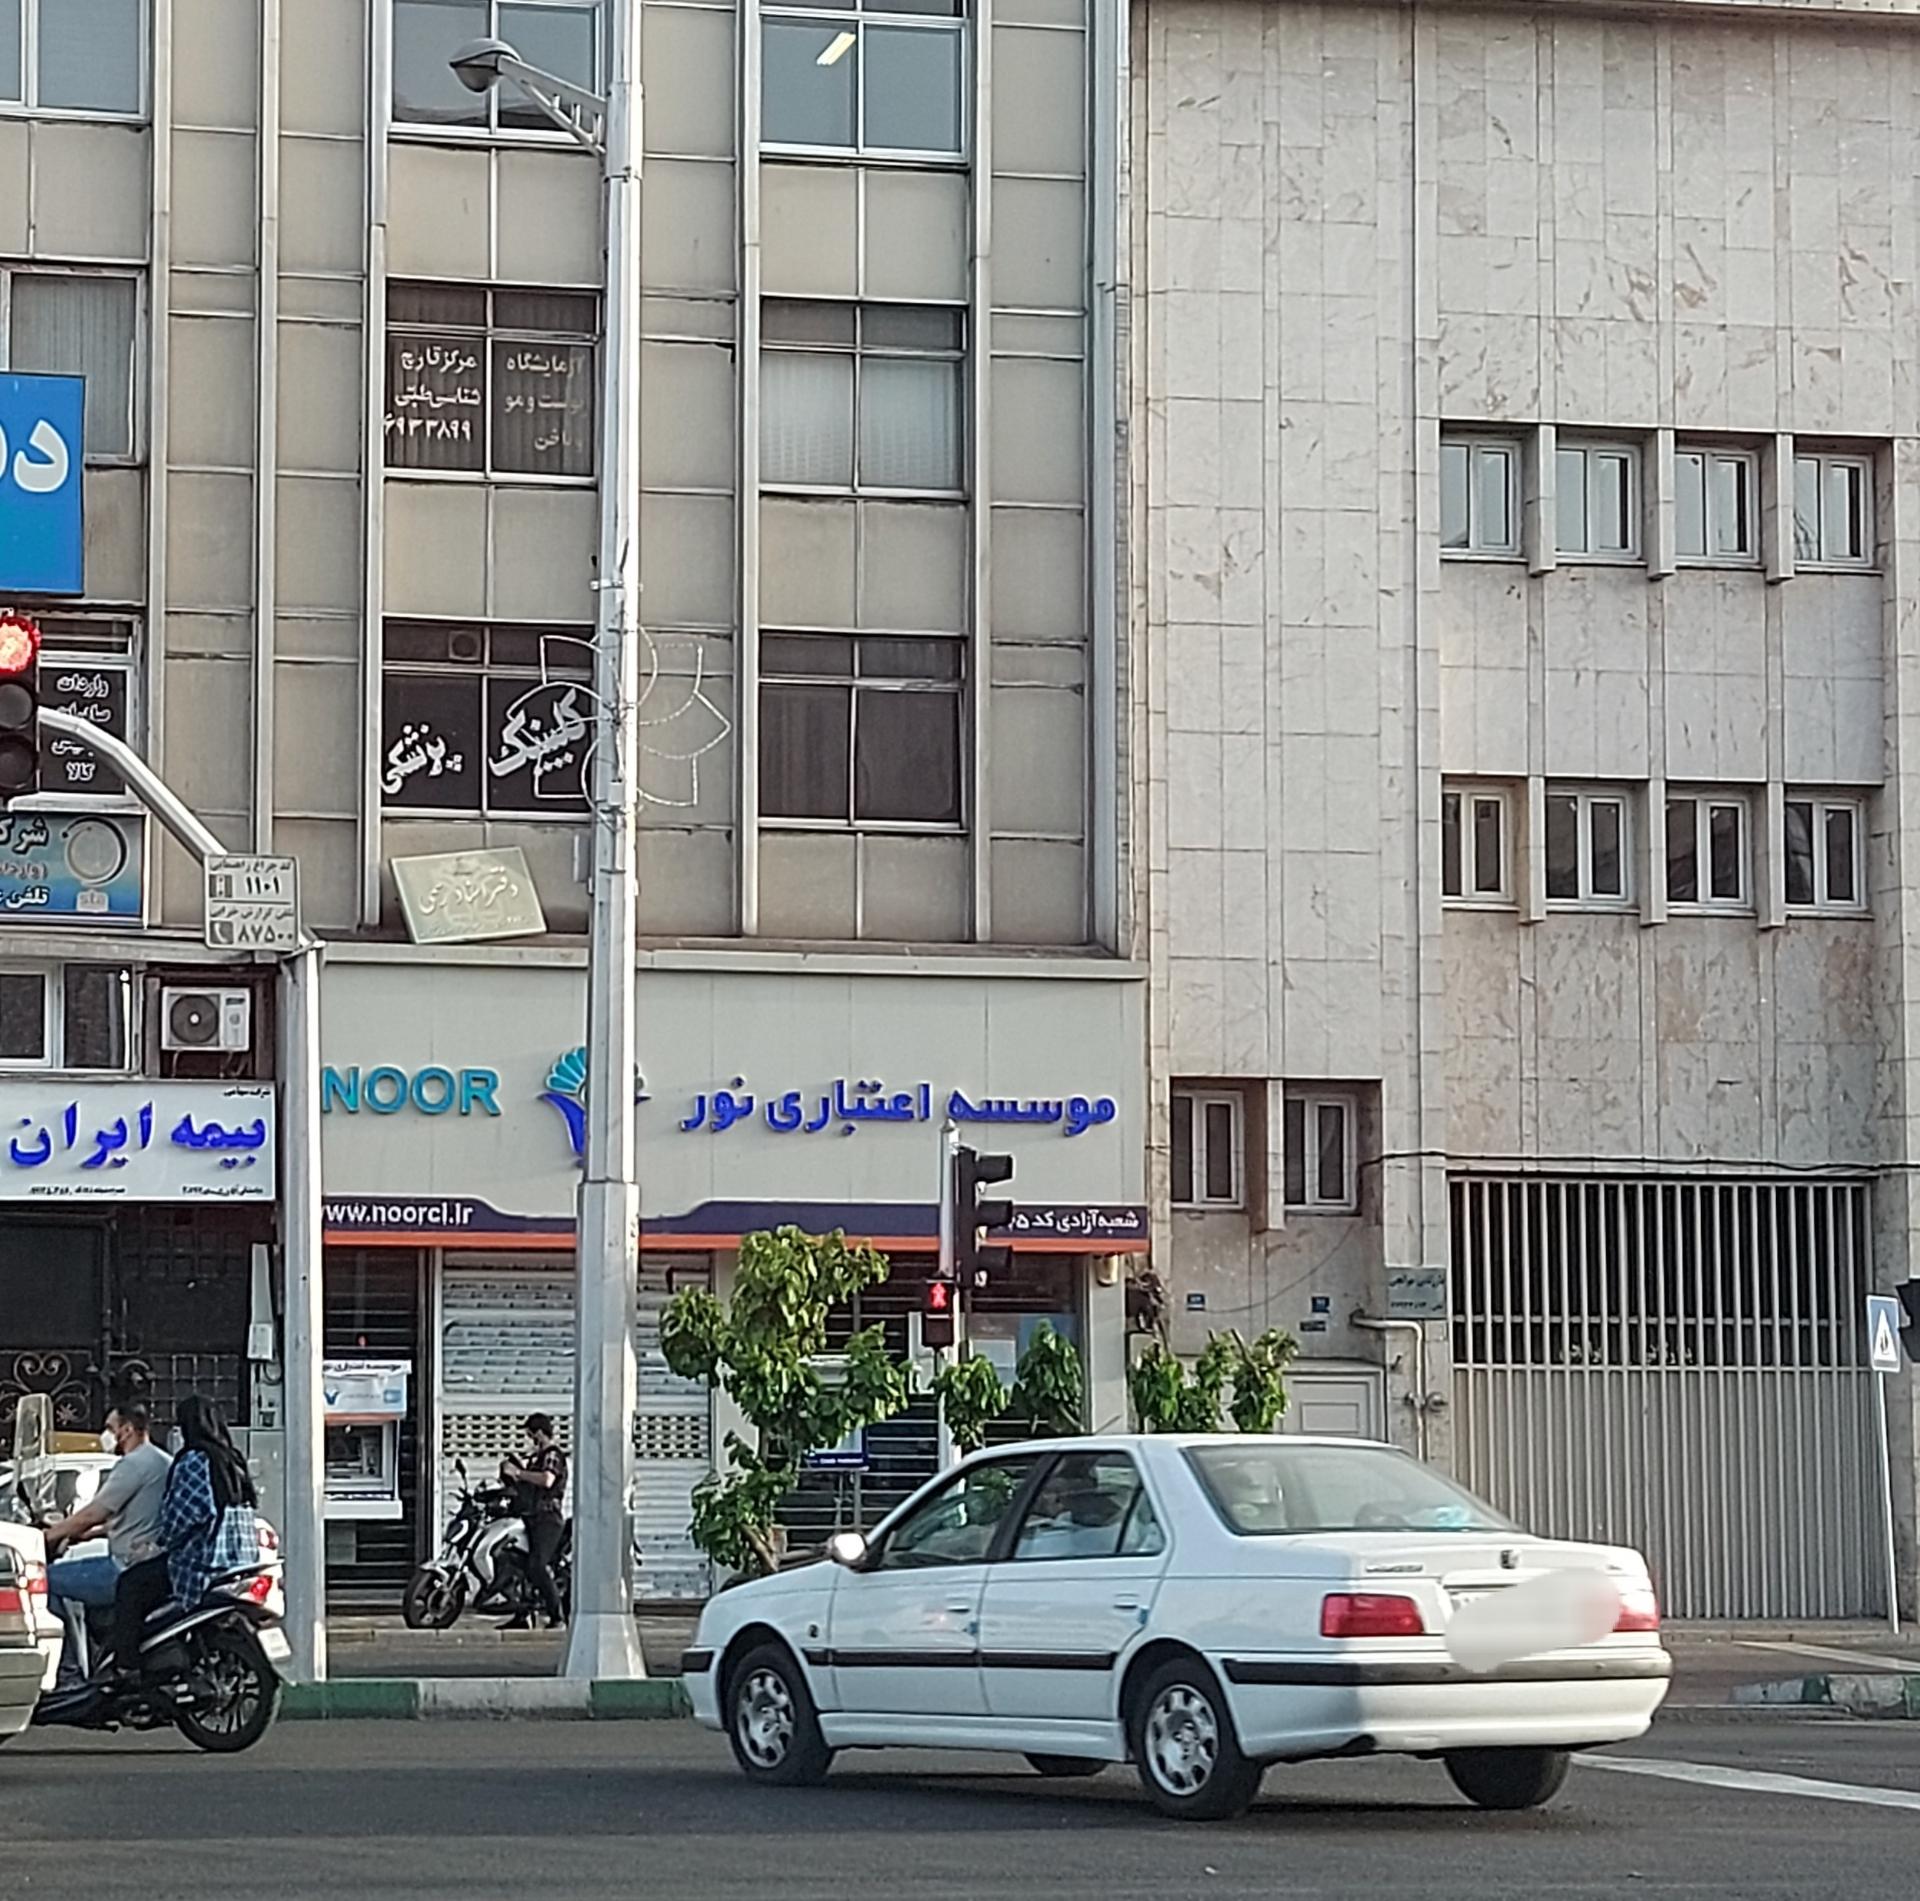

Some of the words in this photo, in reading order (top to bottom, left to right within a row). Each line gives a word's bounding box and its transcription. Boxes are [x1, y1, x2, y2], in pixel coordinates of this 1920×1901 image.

[401, 346, 441, 370] قارچ
[439, 349, 477, 373] مرکز
[431, 387, 481, 408] شناسی
[489, 687, 586, 777] کلینیک
[246, 876, 280, 895] ۱۱۰۱
[238, 924, 293, 943] ۸۷۵۰۰
[321, 1066, 502, 1116] NOOR
[680, 1076, 755, 1132] نور
[766, 1078, 931, 1135] اعتباری
[947, 1089, 1116, 1136] موسسه
[10, 1101, 153, 1168] ایران
[171, 1113, 266, 1169] بیمه
[321, 1201, 473, 1226] ww.noorci.ir
[1031, 1211, 1054, 1228] کد
[1056, 1209, 1099, 1233] آزادی
[1098, 1211, 1139, 1234] شعبه
